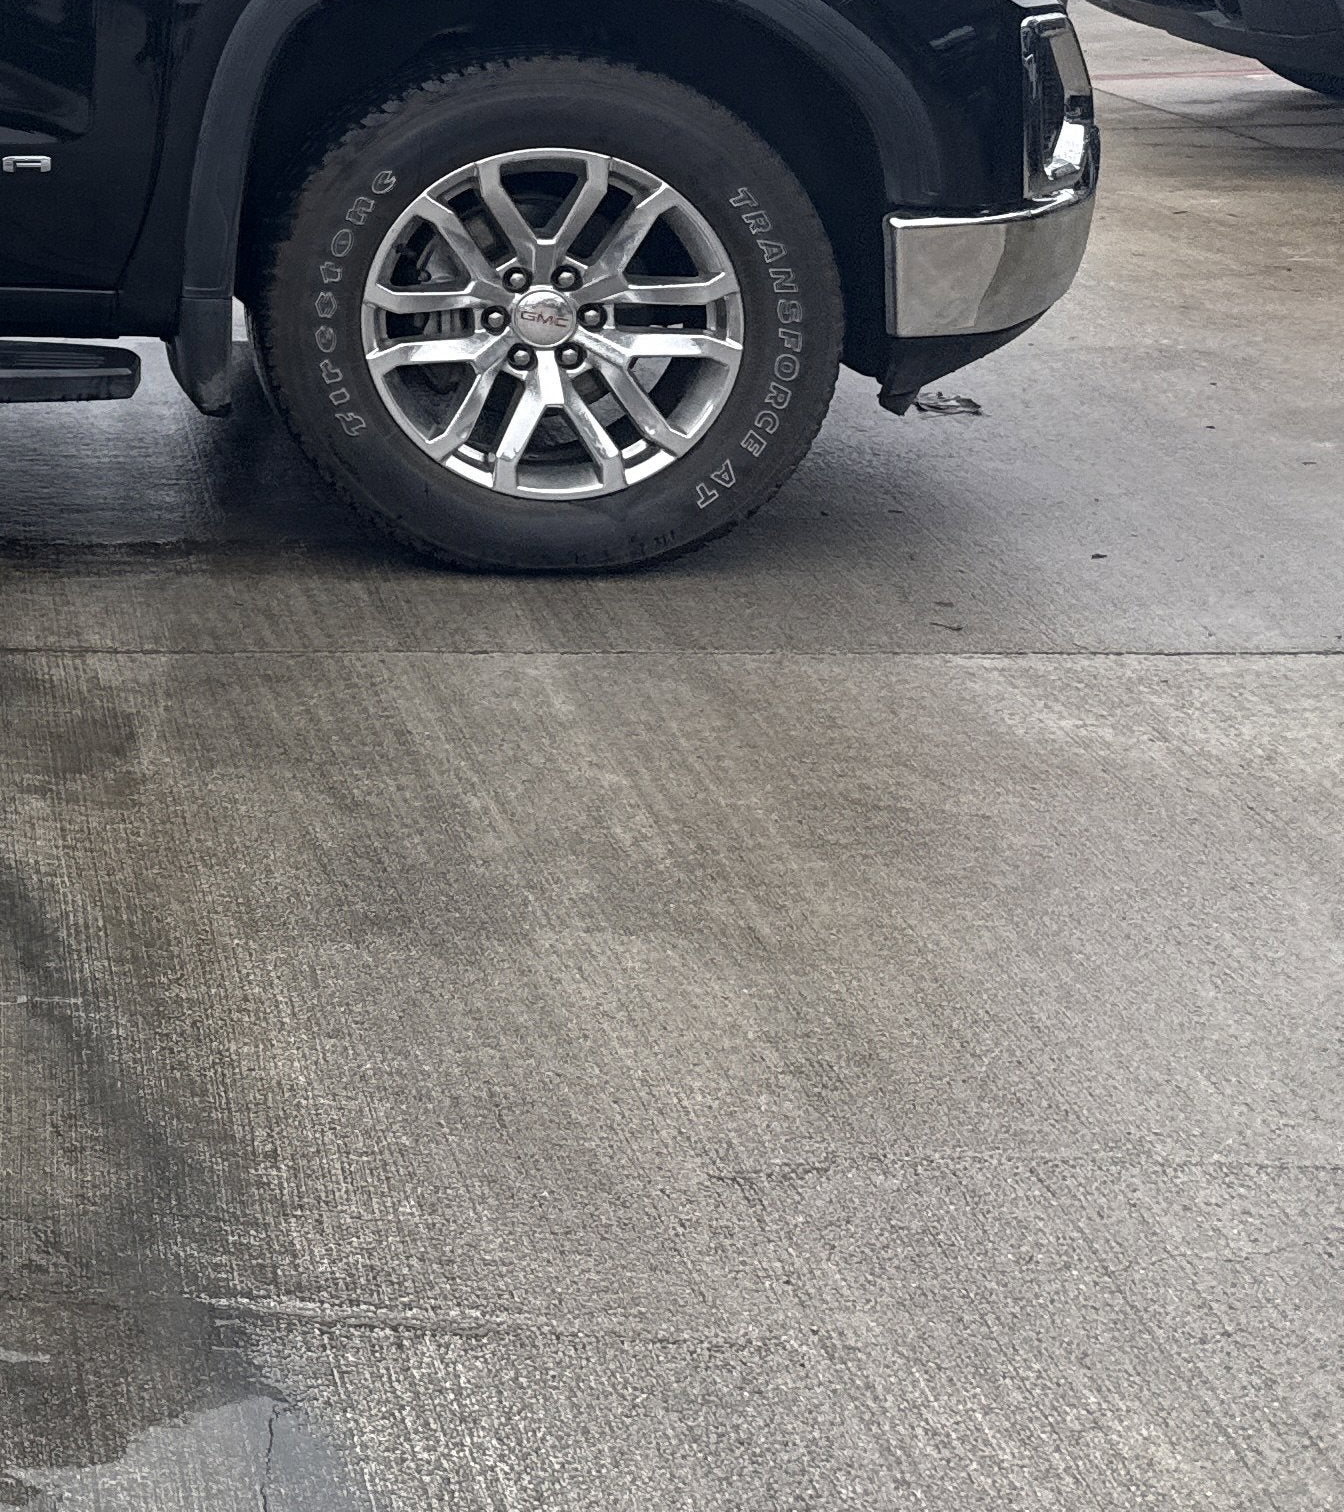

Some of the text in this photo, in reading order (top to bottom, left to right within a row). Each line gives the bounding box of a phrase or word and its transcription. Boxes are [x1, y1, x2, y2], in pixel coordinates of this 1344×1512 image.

[314, 170, 397, 437] Firestone
[520, 310, 570, 328] GMC
[695, 187, 803, 510] TRANSFORCE AT
